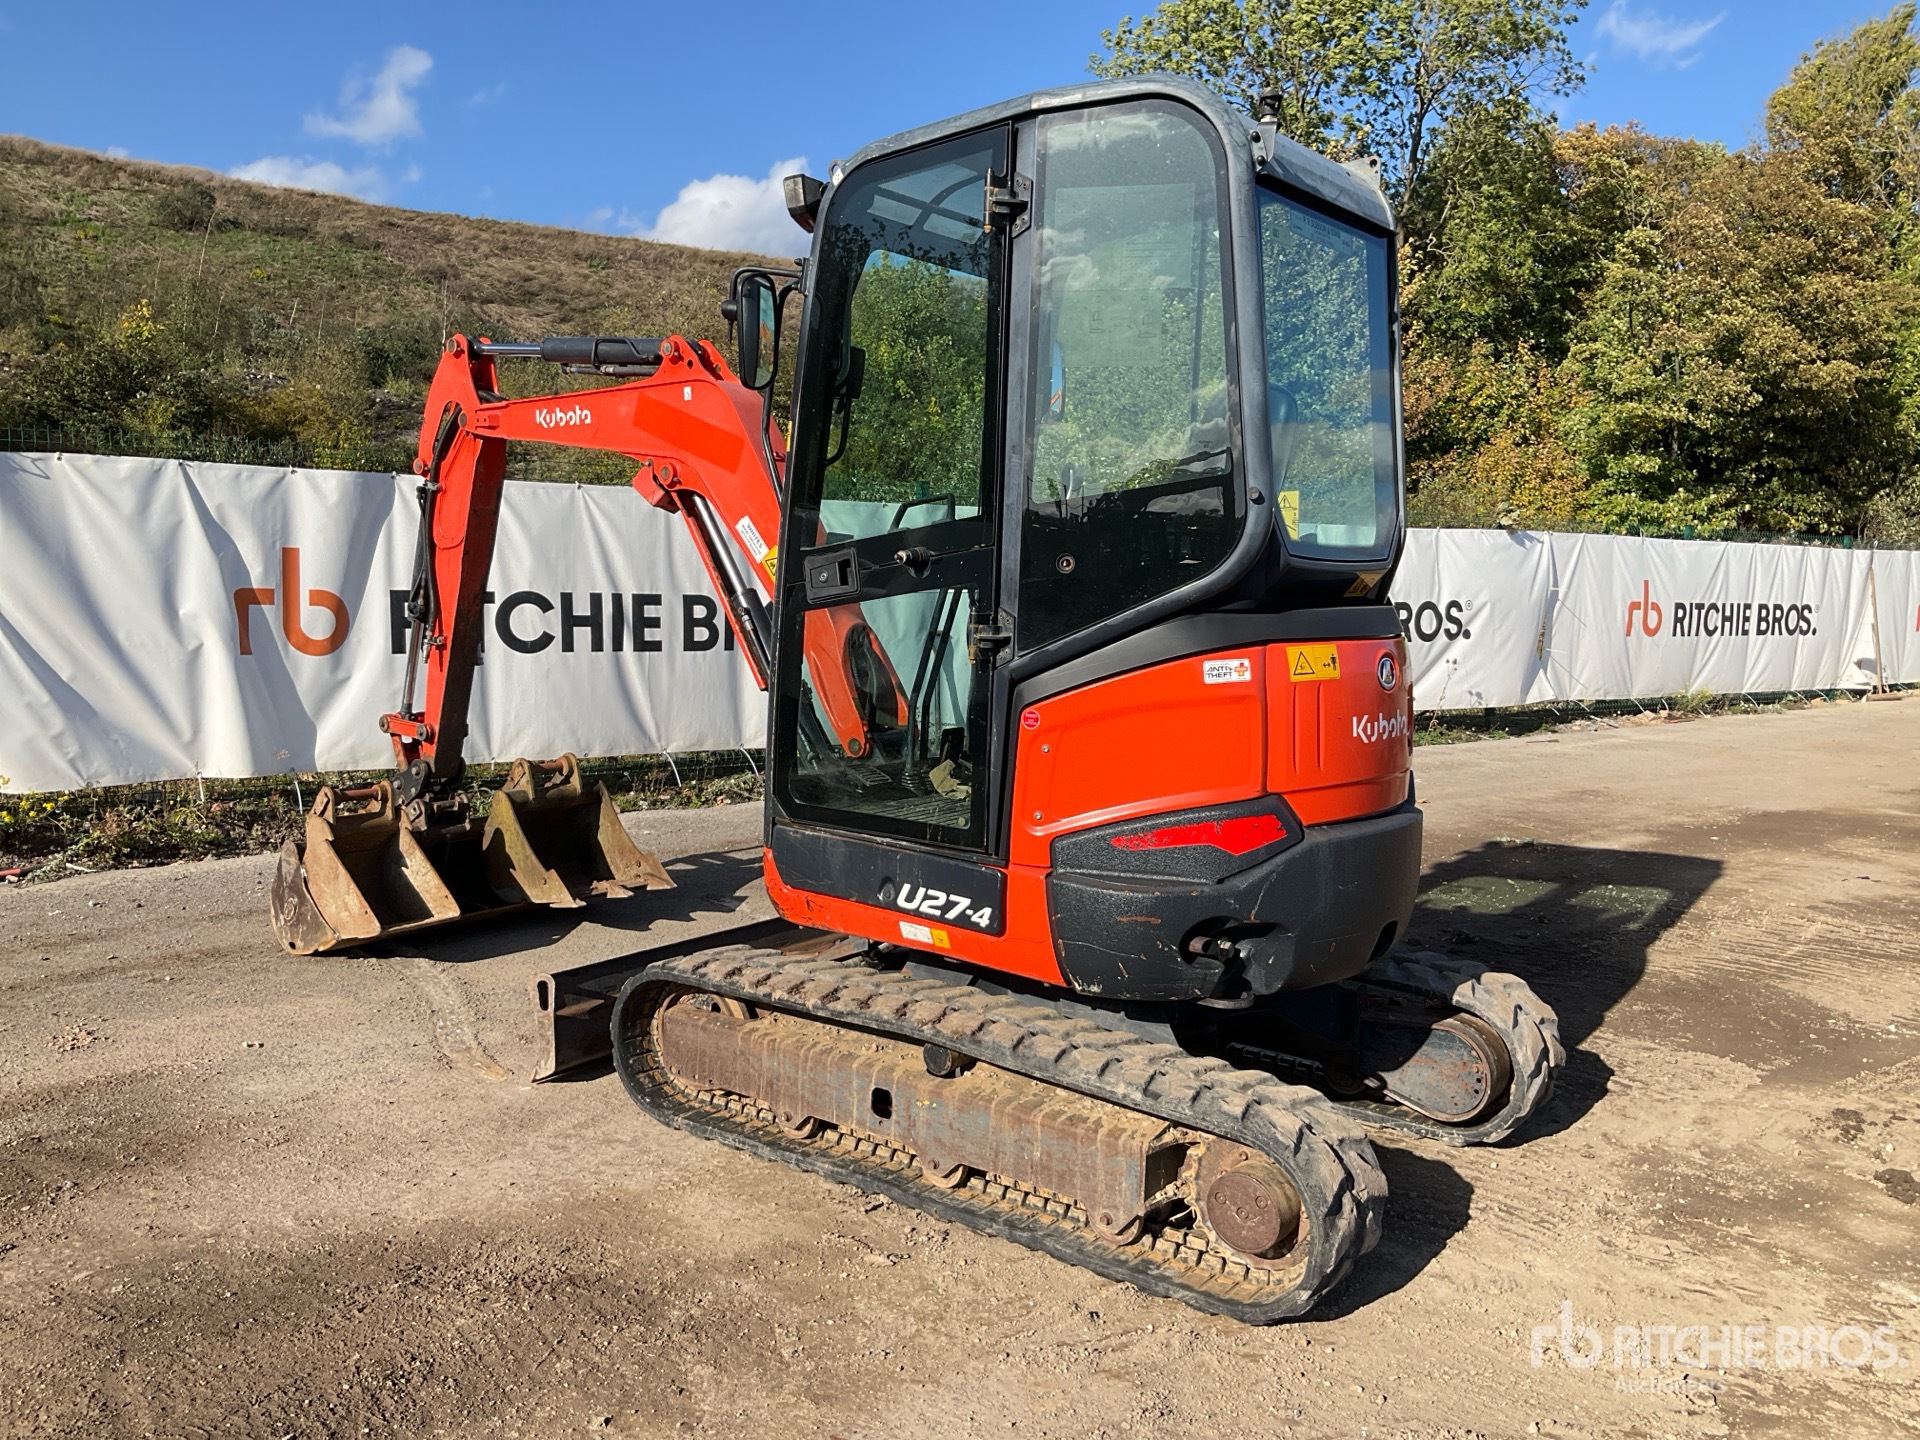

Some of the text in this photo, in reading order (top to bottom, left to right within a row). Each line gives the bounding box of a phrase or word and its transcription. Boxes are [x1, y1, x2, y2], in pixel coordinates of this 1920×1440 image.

[535, 406, 591, 428] Kubota
[233, 547, 351, 657] rb
[389, 589, 663, 654] RCHIE
[1394, 600, 1471, 642] ROS.
[1626, 579, 1663, 638] rb
[1672, 602, 1752, 637] RITCHIE
[1207, 671, 1233, 679] THEFT
[1352, 709, 1410, 743] Kubota
[896, 883, 993, 928] U27-4
